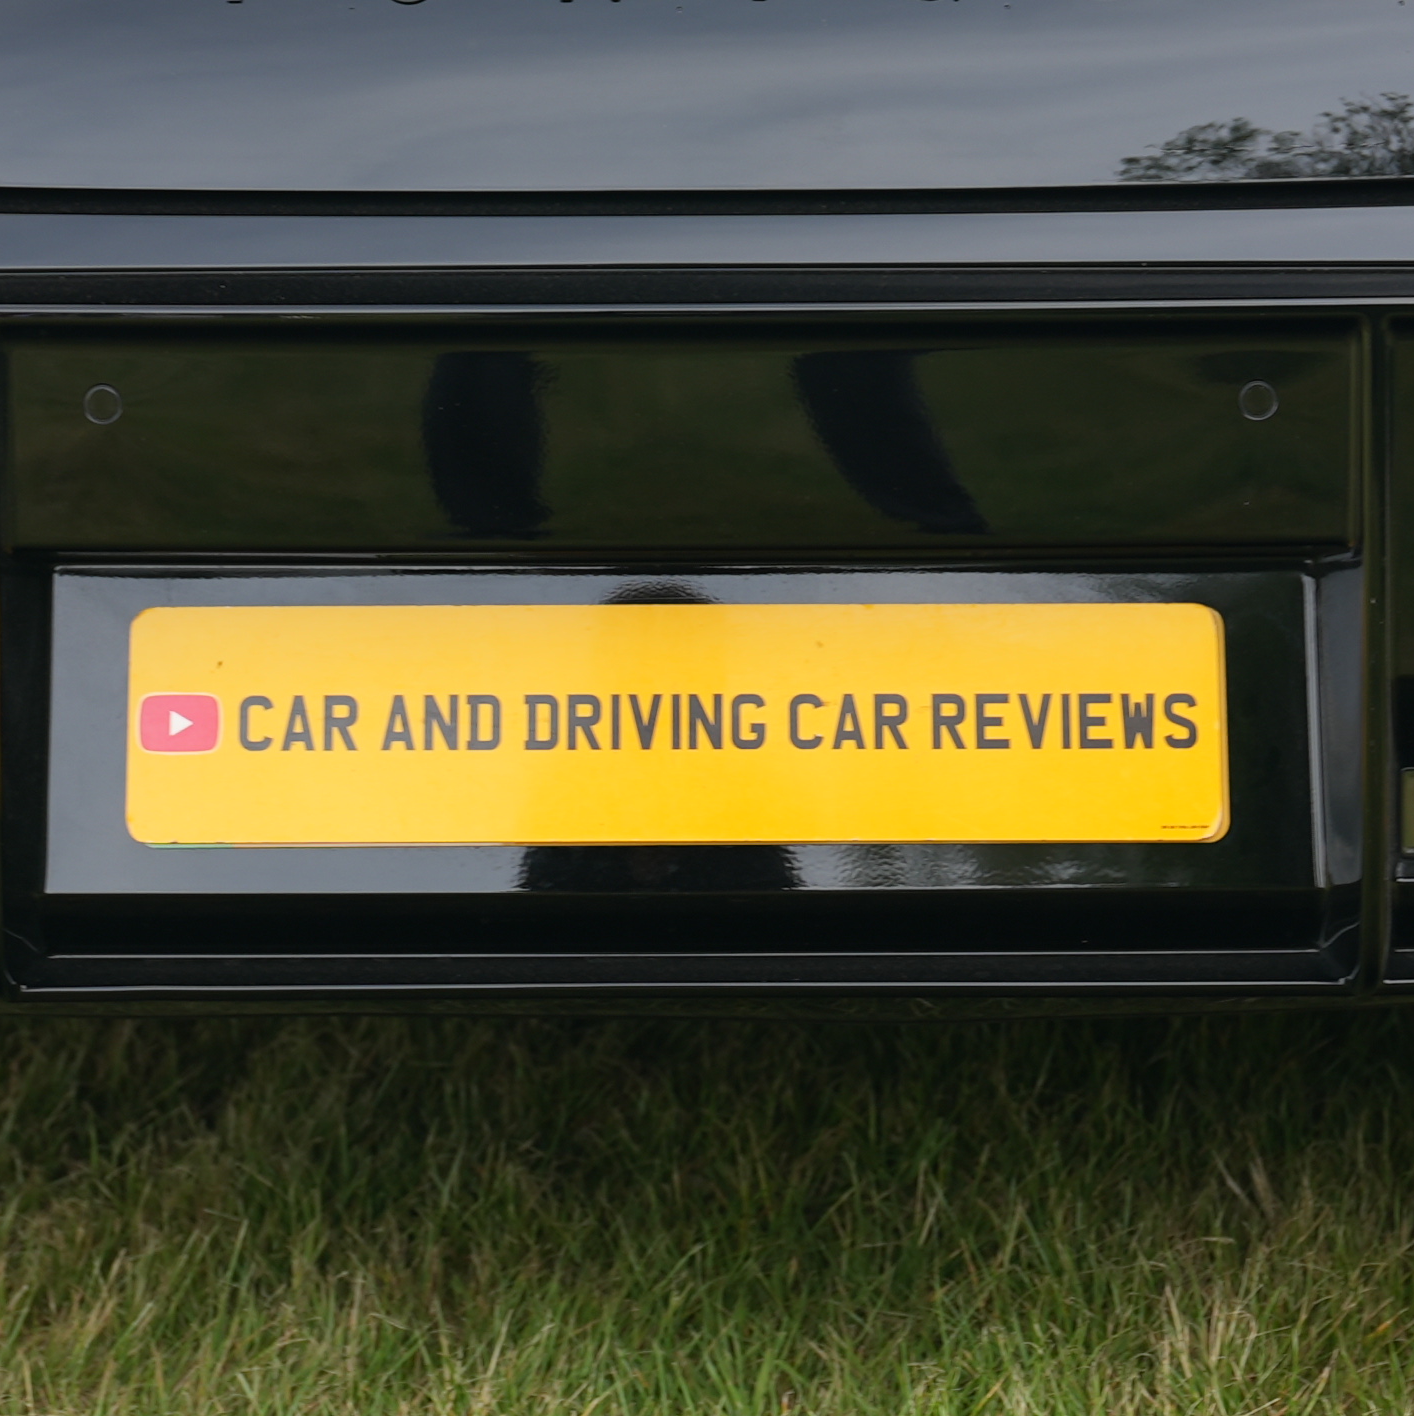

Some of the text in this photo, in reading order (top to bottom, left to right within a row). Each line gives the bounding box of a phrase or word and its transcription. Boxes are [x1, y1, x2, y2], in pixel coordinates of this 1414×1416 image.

[238, 692, 1198, 752] CAR AND DRIVING CAR REVIEWS
